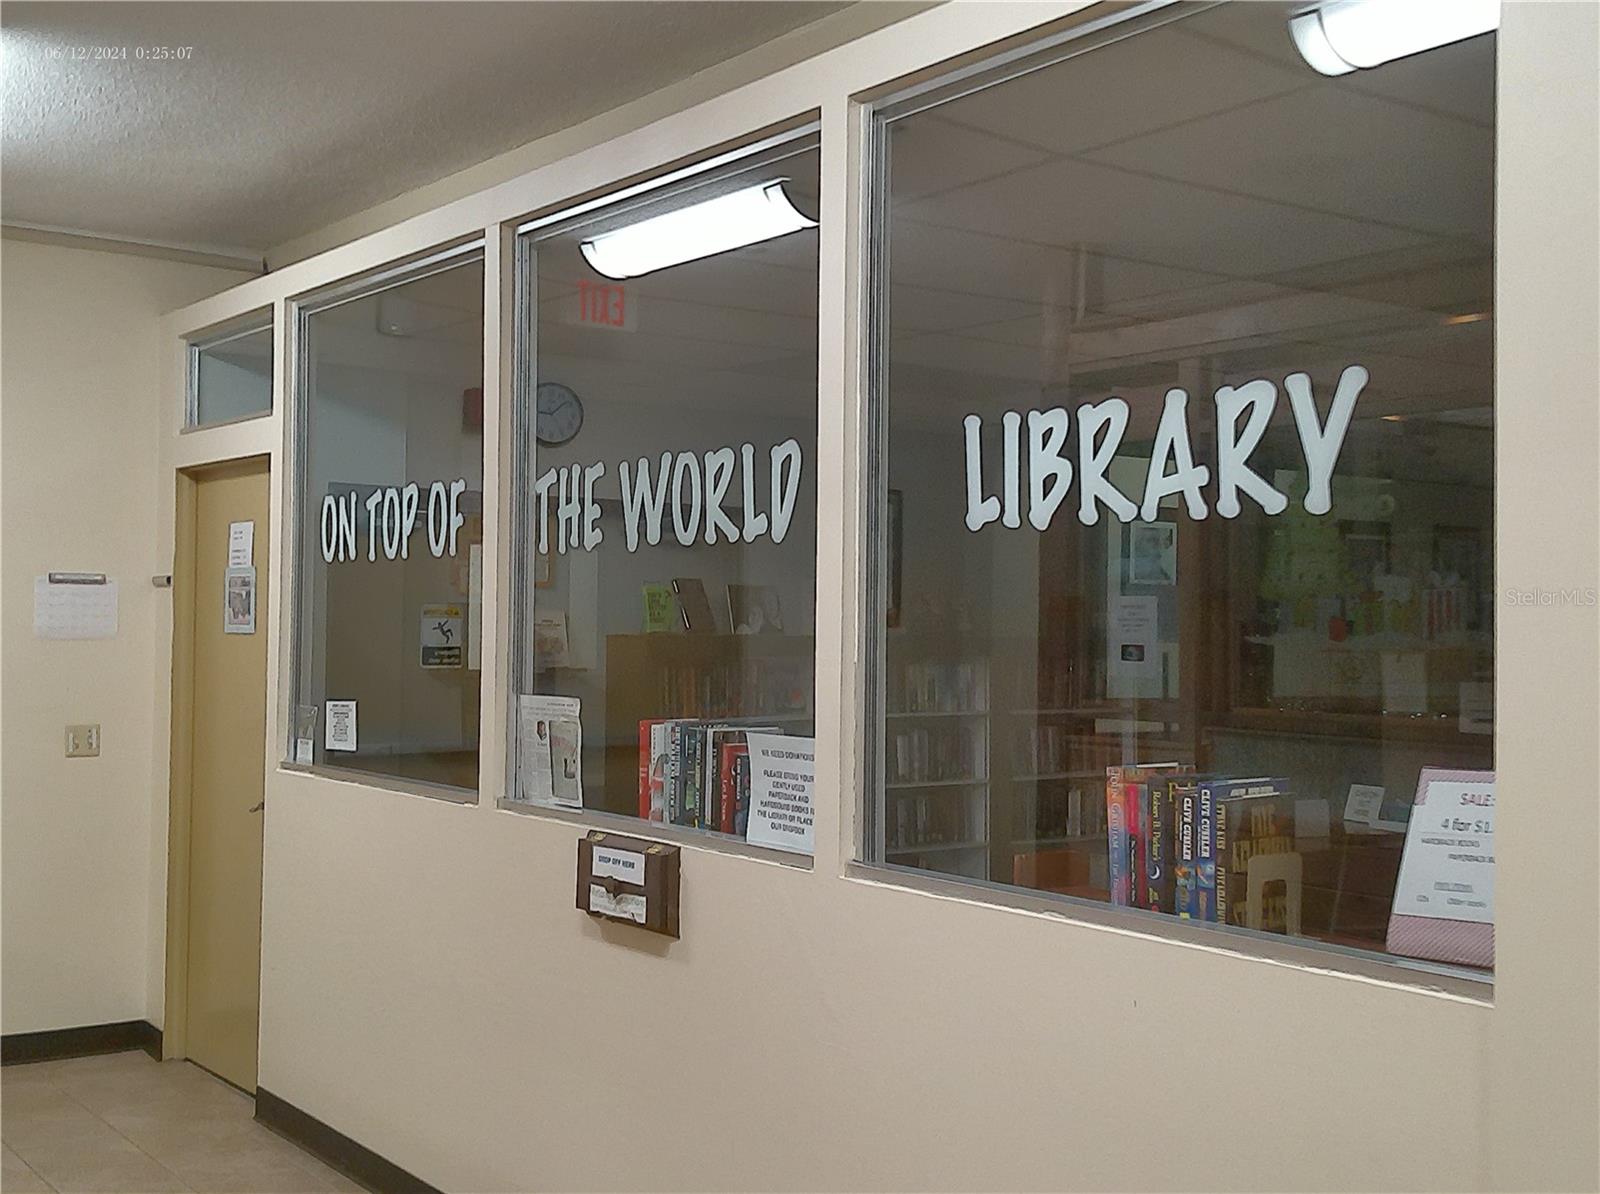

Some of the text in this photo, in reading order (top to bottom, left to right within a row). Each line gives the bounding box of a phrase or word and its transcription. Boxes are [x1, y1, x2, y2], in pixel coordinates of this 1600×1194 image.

[321, 491, 359, 564] ON
[365, 481, 421, 563] TOP
[427, 478, 466, 559] OF
[534, 460, 606, 556] THE
[618, 438, 802, 553] WORLD
[963, 364, 1370, 533] LIBRARY
[763, 768, 783, 779] PLEASE
[772, 780, 806, 793] GENTLY USED
[797, 794, 810, 804] AND
[1153, 791, 1162, 818] Robert
[757, 808, 767, 818] THE
[796, 816, 814, 827] PLACE
[1182, 797, 1193, 862] CLIVE CUSSLER
[1200, 789, 1211, 858] CLIVE CUSSLER
[1153, 831, 1162, 861] Parker's
